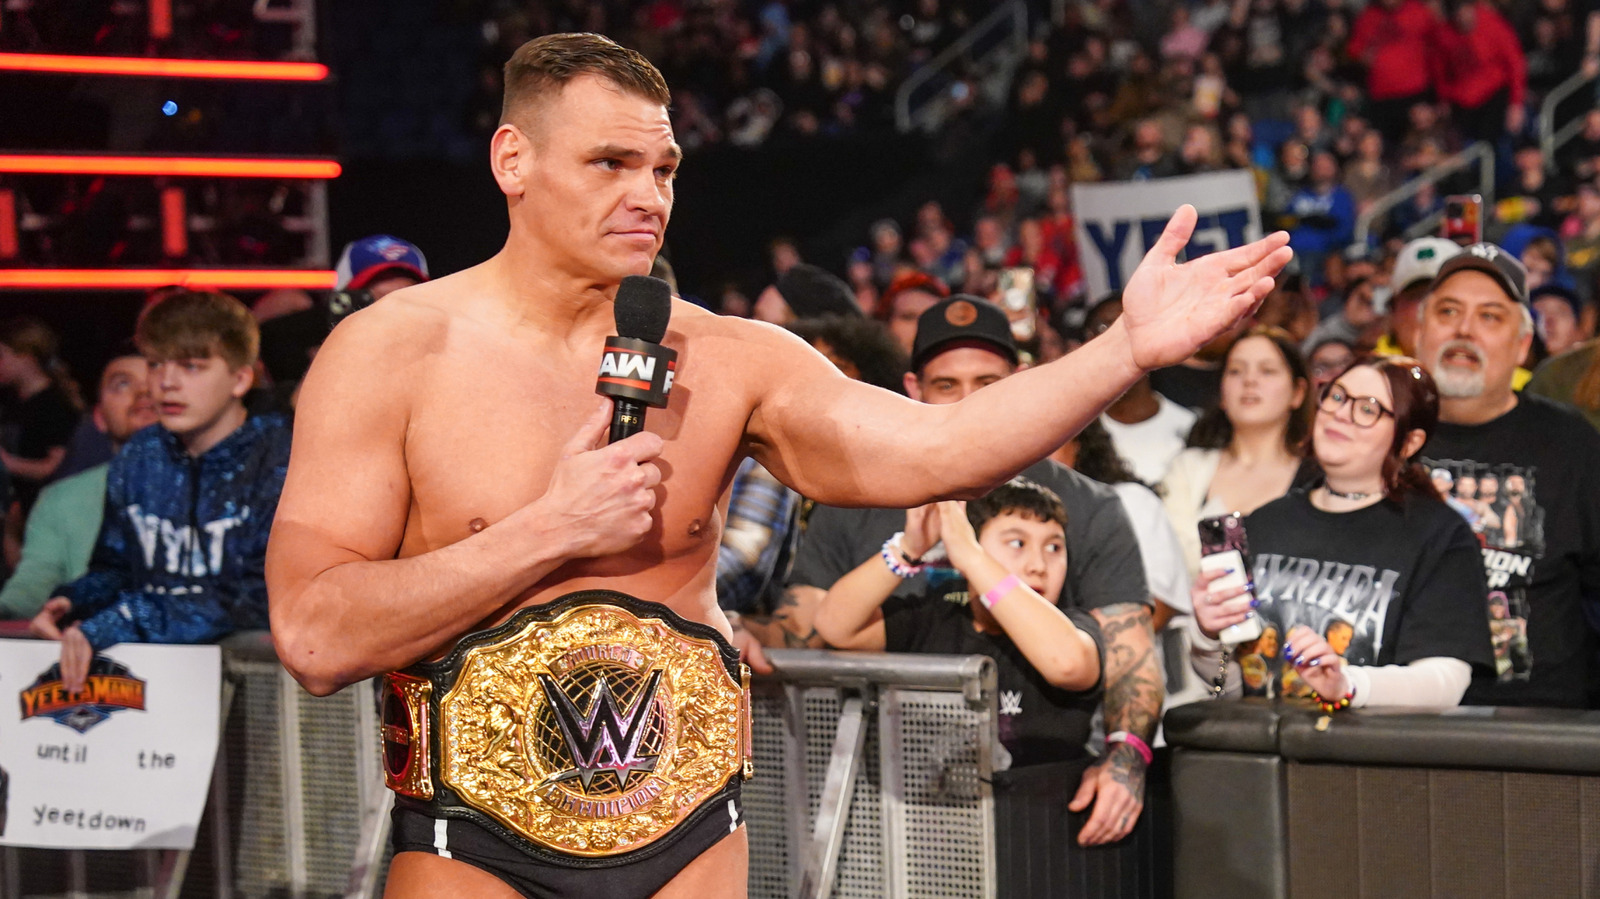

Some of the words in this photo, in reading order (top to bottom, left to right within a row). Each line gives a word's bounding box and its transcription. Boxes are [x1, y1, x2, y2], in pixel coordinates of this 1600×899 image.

[1481, 548, 1532, 577] ION
[37, 744, 88, 763] until
[138, 751, 176, 769] the
[33, 804, 147, 832] yeetdown
